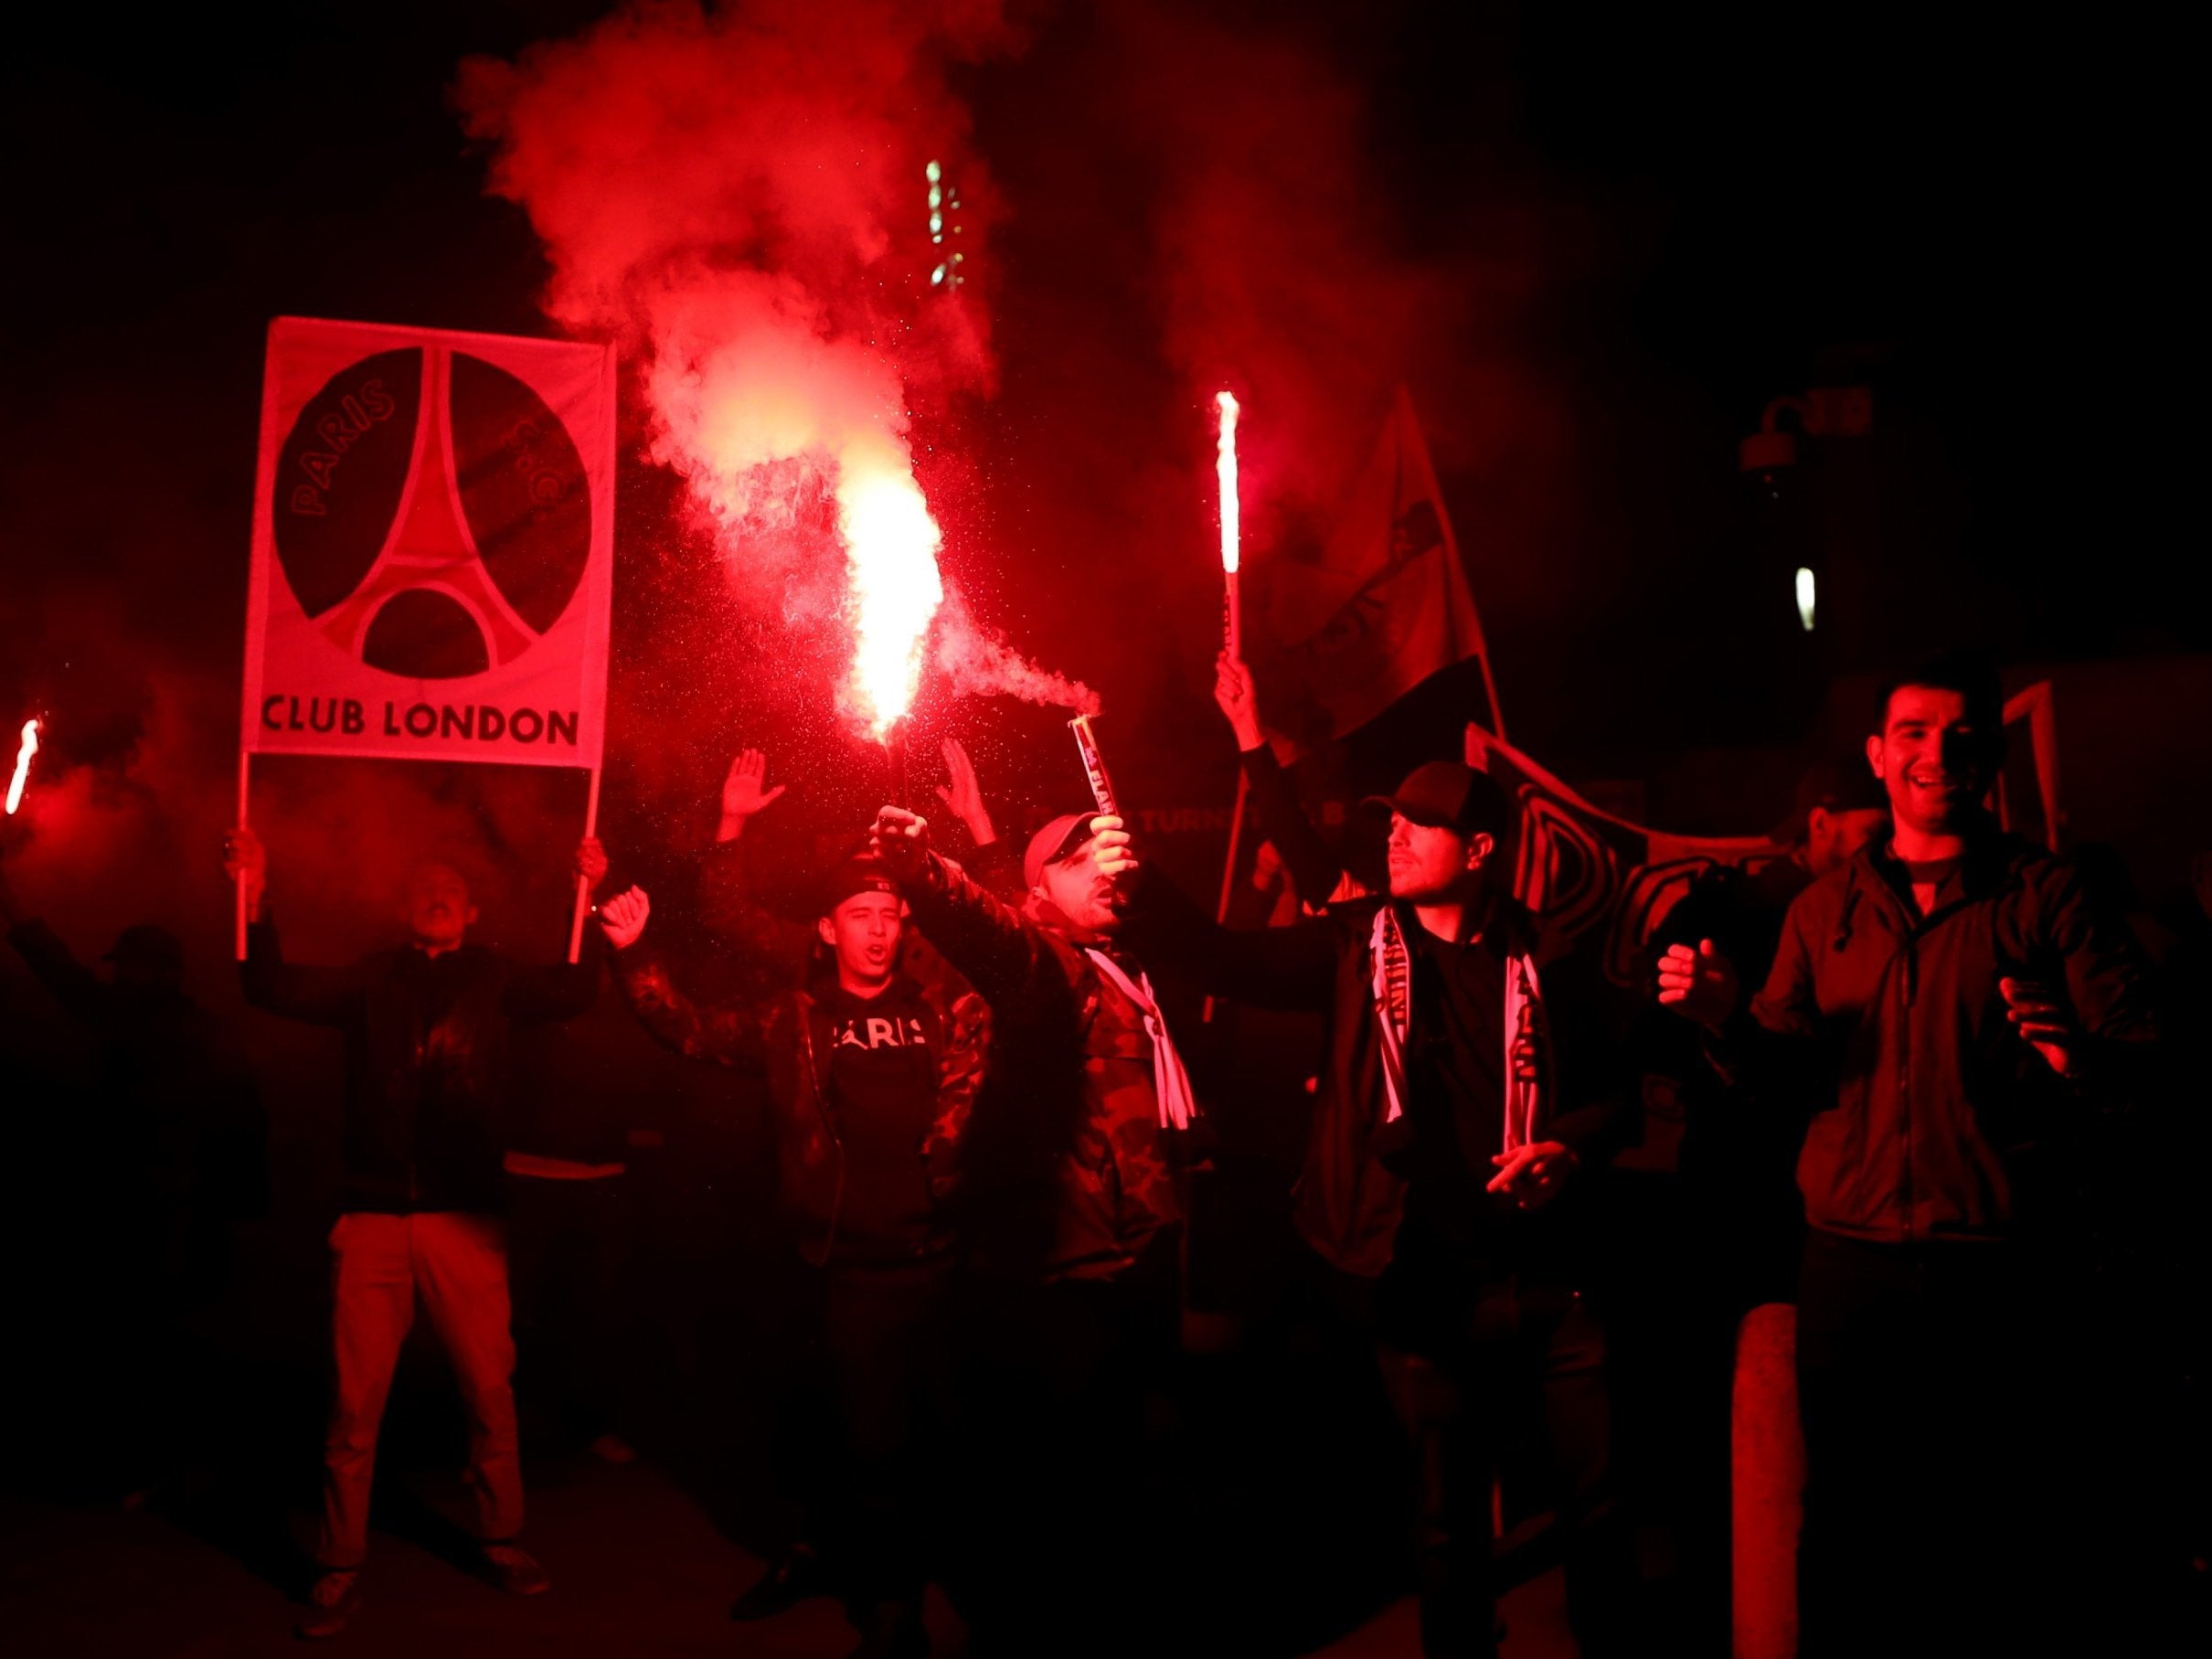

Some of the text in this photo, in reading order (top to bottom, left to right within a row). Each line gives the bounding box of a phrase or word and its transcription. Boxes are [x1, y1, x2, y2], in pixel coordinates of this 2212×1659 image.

[290, 379, 396, 516] PARIS
[261, 694, 579, 746] CLUB LONDON
